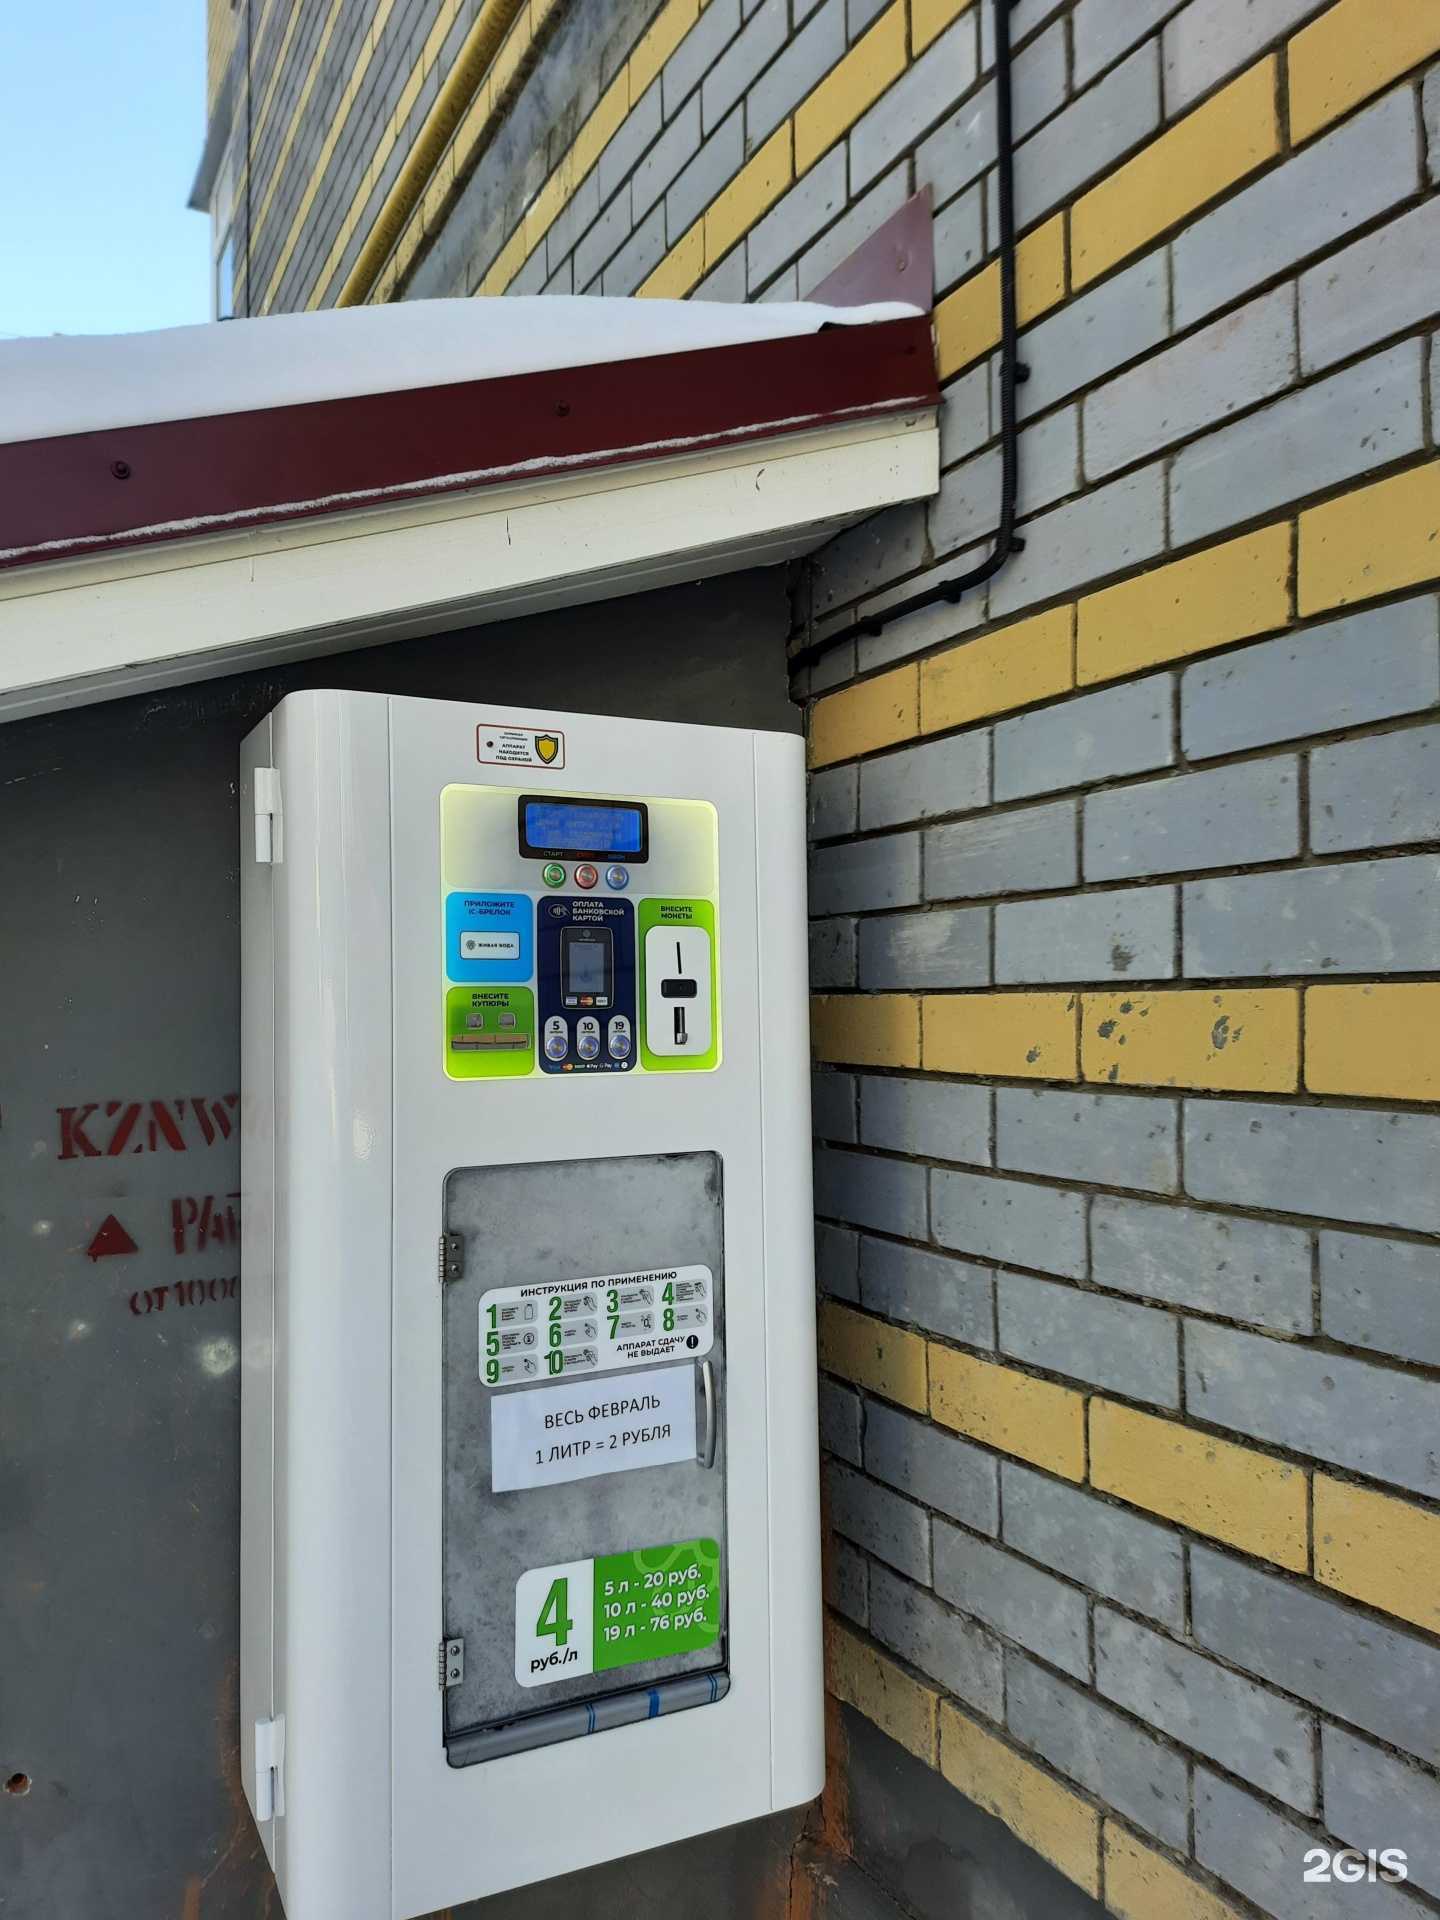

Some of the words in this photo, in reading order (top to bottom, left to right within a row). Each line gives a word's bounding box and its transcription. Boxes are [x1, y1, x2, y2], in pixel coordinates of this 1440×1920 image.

[464, 900, 515, 908] ПРИЛОЖИТЕ
[572, 908, 625, 916] БАНКОВСКОЙ
[660, 905, 693, 913] ВНЕСИТЕ
[472, 1000, 510, 1008] КУПЮРЫ
[552, 1020, 560, 1031] 5
[582, 1022, 594, 1031] 10
[614, 1021, 625, 1030] 19
[520, 1282, 588, 1297] ИНСТРУКЦИЯ
[591, 1279, 605, 1288] ПО
[608, 1271, 677, 1287] ПРИМЕНЕНИЮ
[661, 1282, 674, 1306] 4
[548, 1296, 562, 1321] 2
[606, 1289, 619, 1313] 3
[486, 1304, 497, 1329] 1
[606, 1314, 620, 1339] 7
[662, 1308, 675, 1332] 8
[486, 1331, 500, 1356] 5
[549, 1323, 562, 1348] 6
[616, 1339, 656, 1352] АППАРАТ
[657, 1336, 686, 1347] СДАЧУ
[543, 1349, 564, 1375] 10
[627, 1351, 639, 1359] НЕ
[640, 1345, 675, 1357] ВЫДАЕТ
[486, 1359, 500, 1383] 9
[544, 1409, 584, 1429] ВЕСЬ
[588, 1394, 661, 1421] ФЕВРАЛЬ
[535, 1450, 544, 1464] 1
[549, 1440, 591, 1462] ЛИТР
[609, 1434, 618, 1449] 2
[622, 1423, 671, 1447] РУБЛЯ
[604, 1581, 613, 1596] 5
[618, 1580, 629, 1593] л
[644, 1570, 664, 1589] 20
[668, 1563, 702, 1585] руб.
[535, 1577, 573, 1647] 4
[603, 1601, 621, 1618] 10
[625, 1601, 636, 1615] л
[651, 1594, 673, 1609] 40
[677, 1583, 710, 1607] руб.
[603, 1624, 621, 1641] 19
[624, 1624, 636, 1639] л
[650, 1616, 670, 1632] 76
[674, 1607, 707, 1629] руб.
[530, 1647, 578, 1673] руб./л
